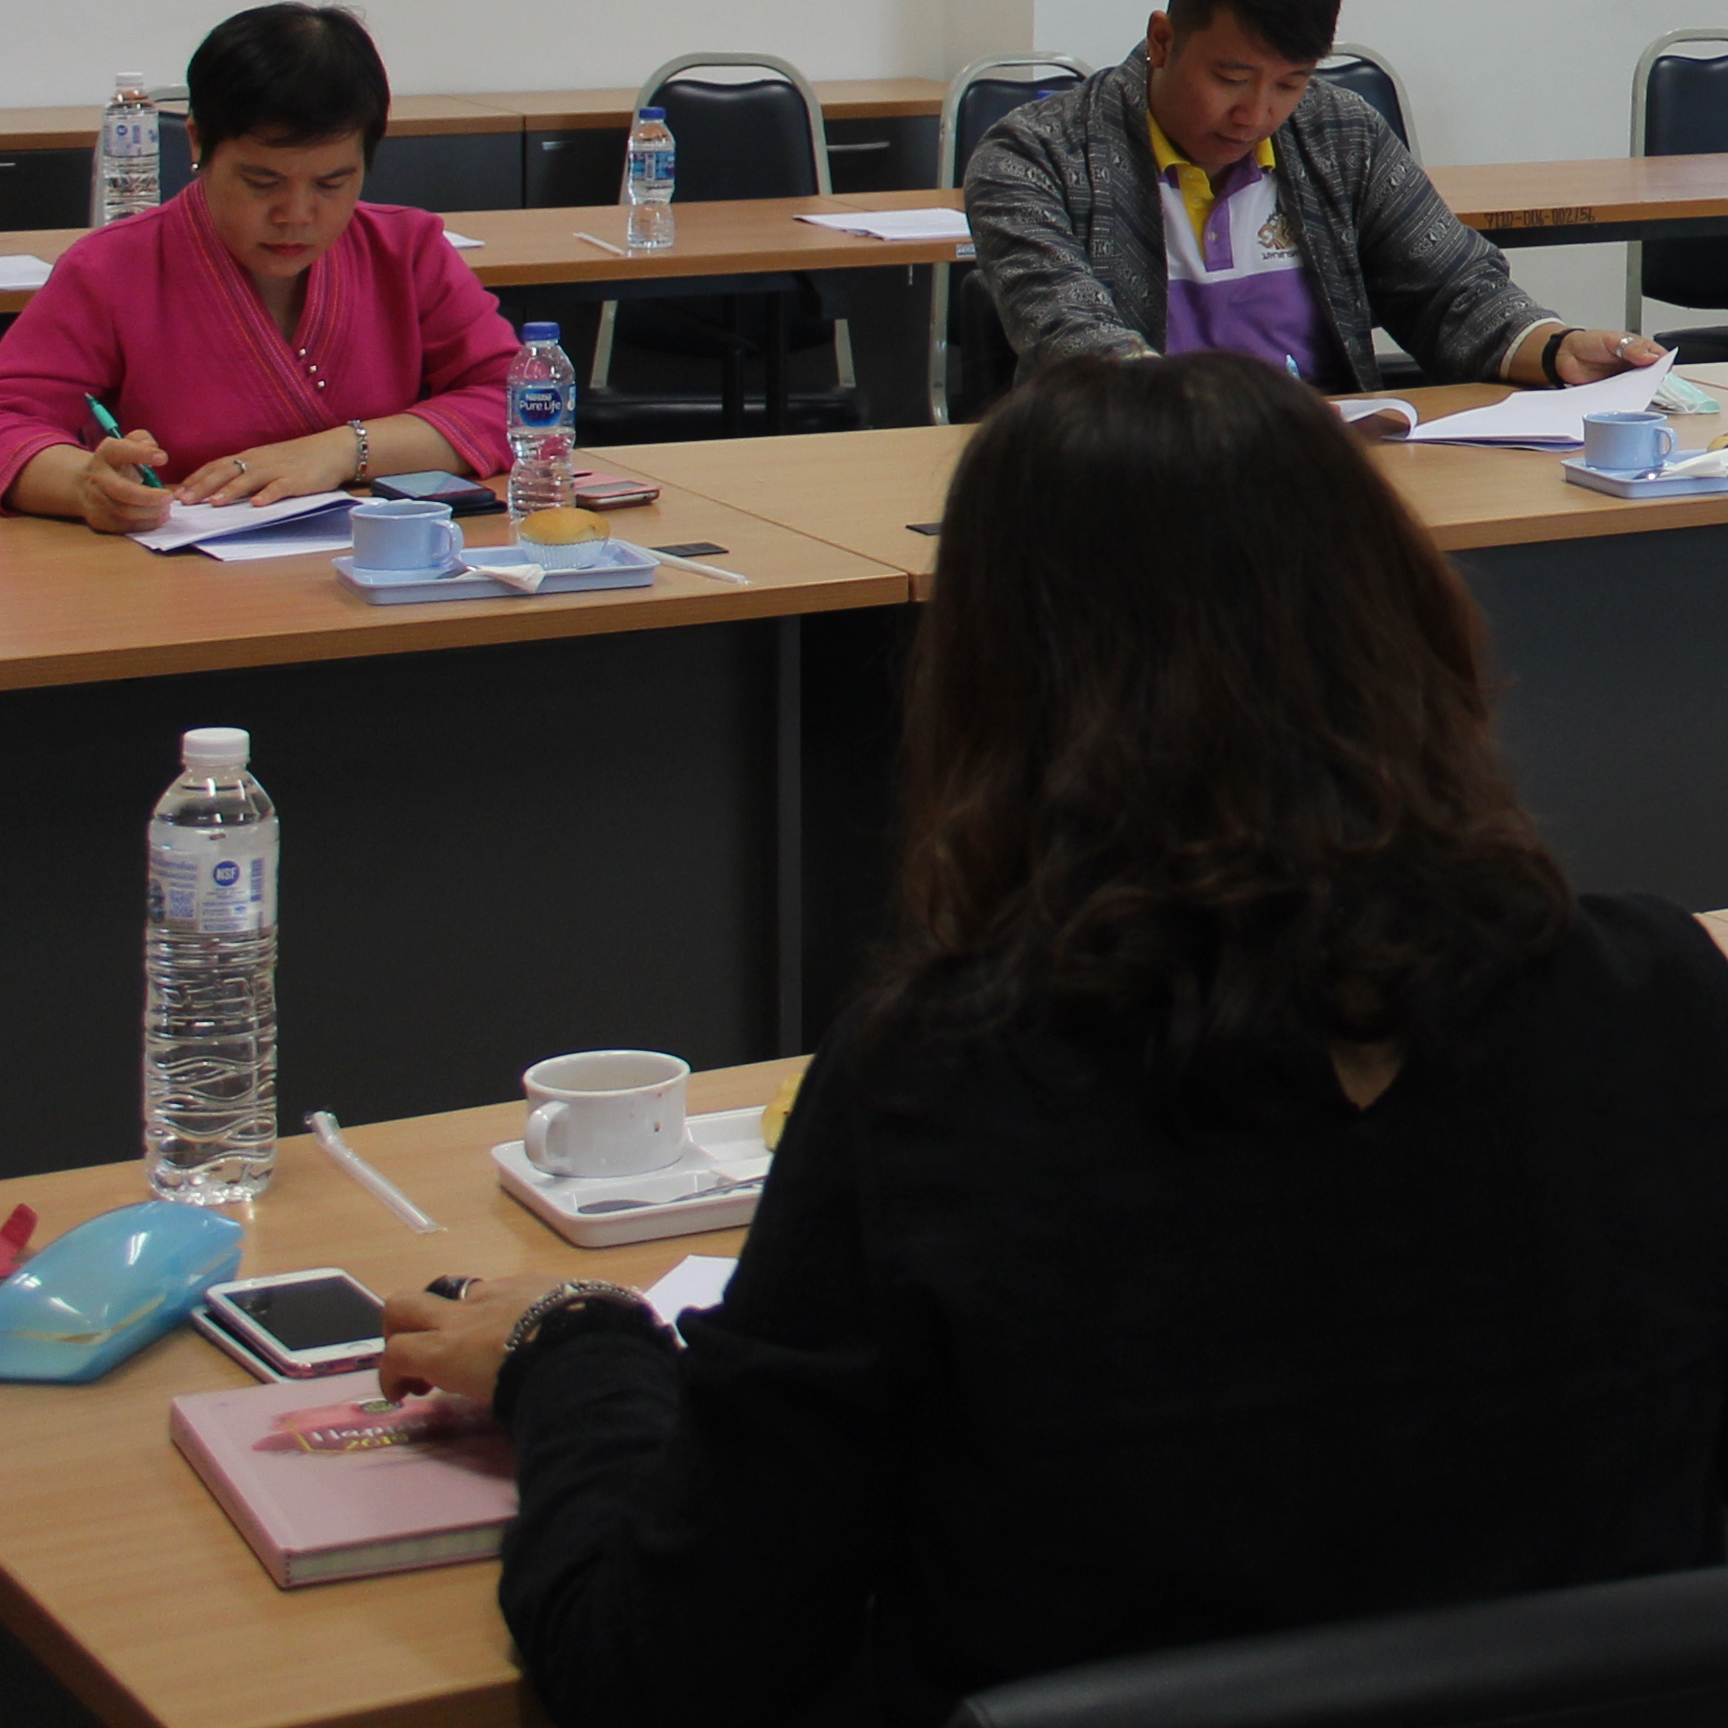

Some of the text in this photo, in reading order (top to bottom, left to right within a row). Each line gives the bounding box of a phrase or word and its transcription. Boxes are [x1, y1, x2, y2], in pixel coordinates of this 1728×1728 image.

[519, 400, 562, 414] Pure Life
[217, 867, 236, 879] NSF
